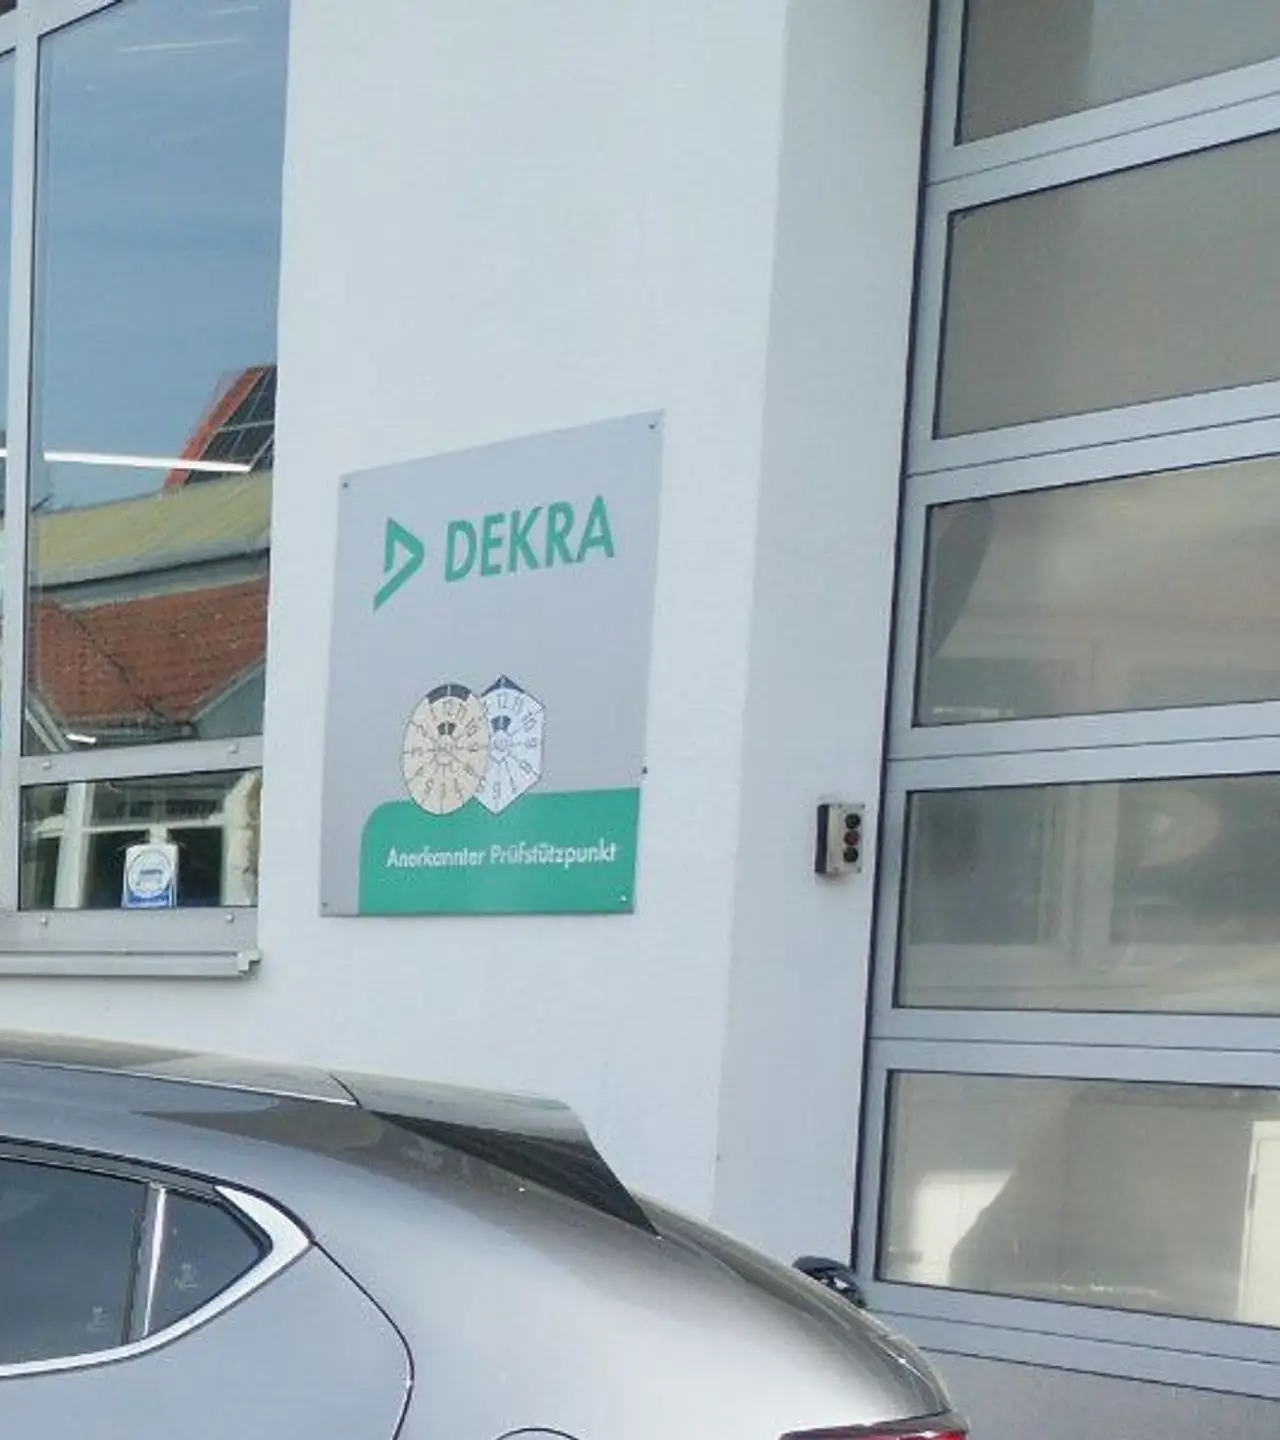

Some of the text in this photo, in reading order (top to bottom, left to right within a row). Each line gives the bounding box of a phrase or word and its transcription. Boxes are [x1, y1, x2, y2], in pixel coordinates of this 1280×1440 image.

[444, 495, 615, 583] DEKRA
[386, 837, 617, 869] Anerkannter Prüfstützpunkt
